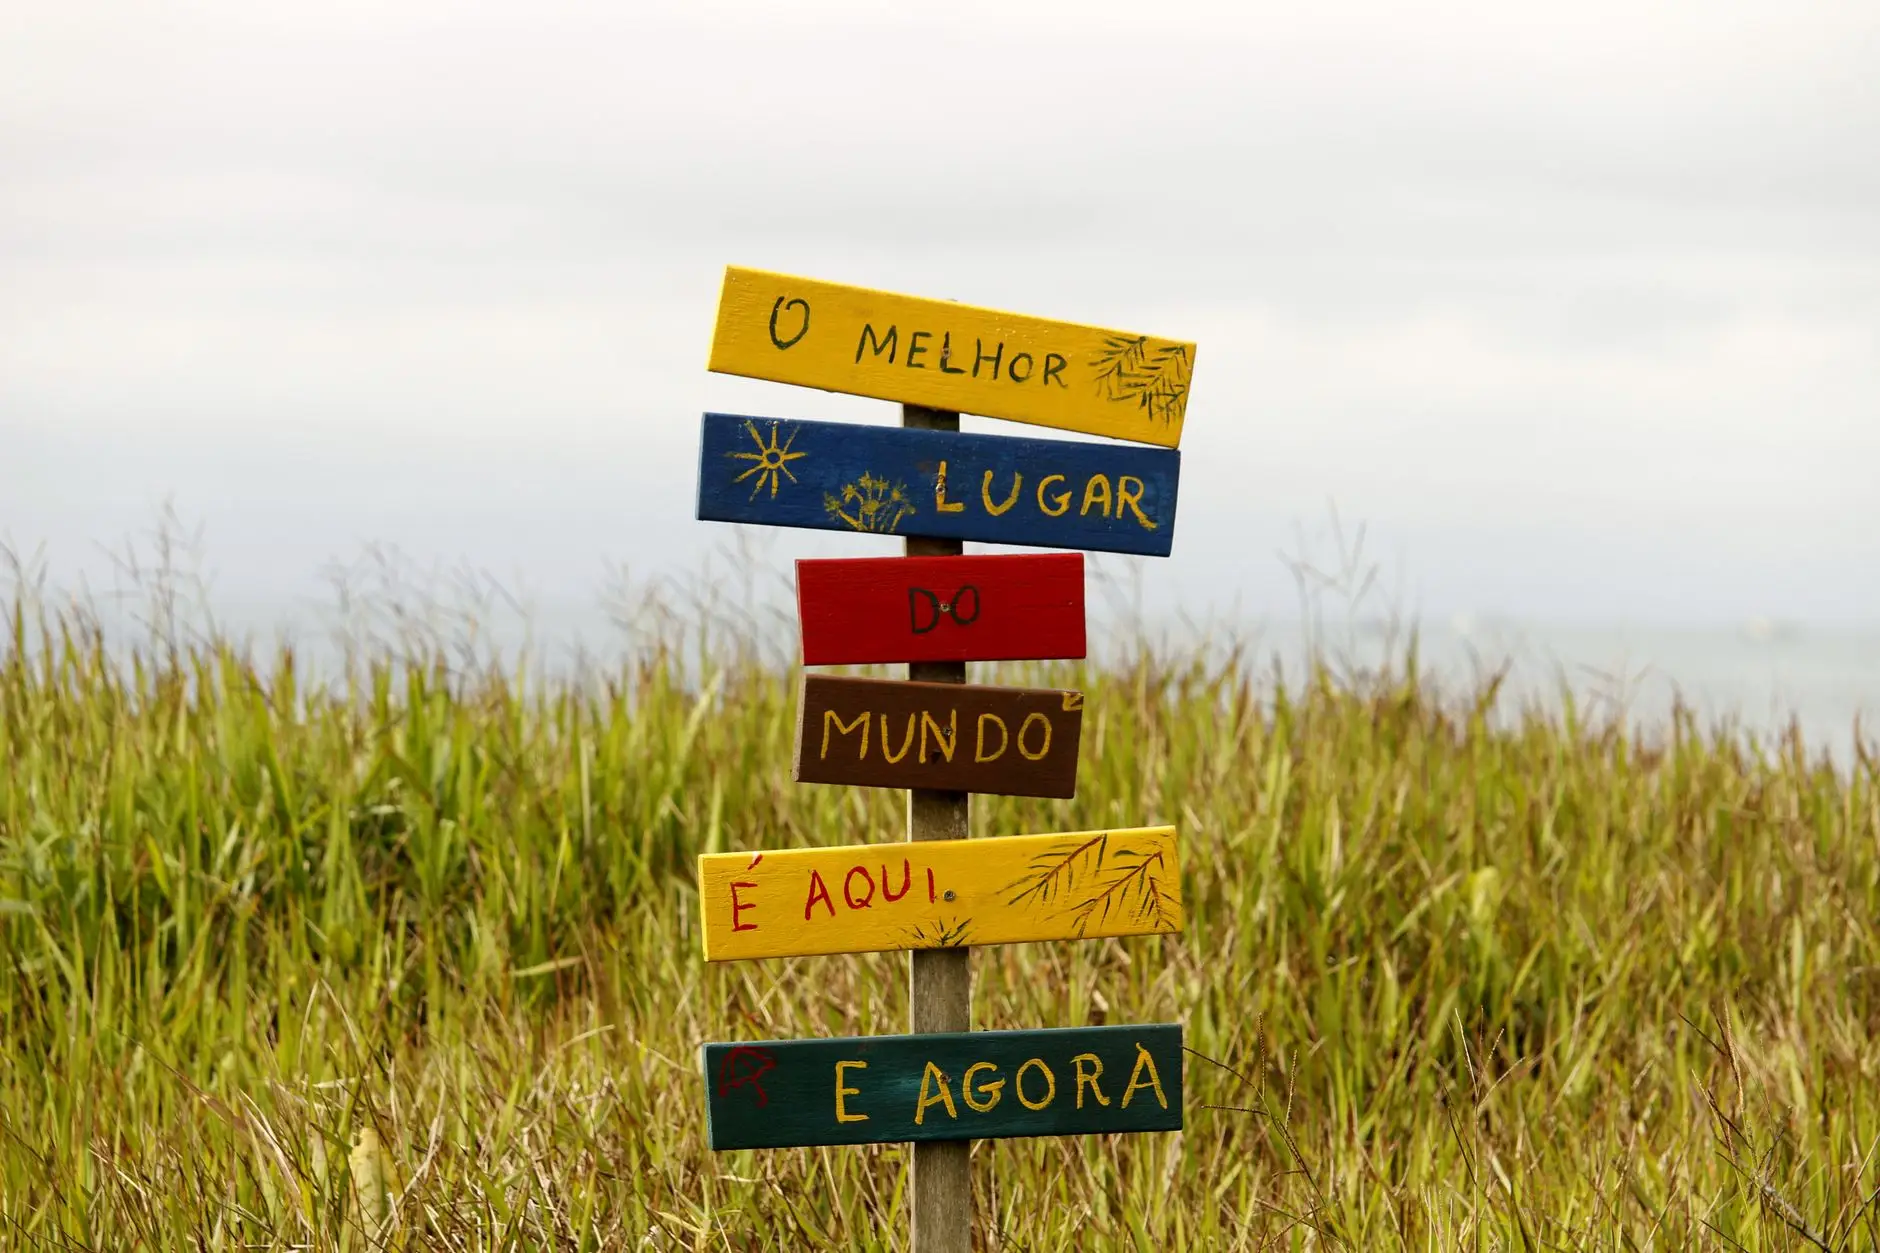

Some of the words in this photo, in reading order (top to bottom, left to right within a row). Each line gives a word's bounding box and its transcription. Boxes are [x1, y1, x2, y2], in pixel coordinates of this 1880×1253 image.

[769, 295, 809, 350] O
[855, 324, 1069, 389] MELHOR
[937, 461, 1158, 530] LUGAR
[909, 585, 980, 634] DO
[821, 709, 1052, 763] MUNDO
[730, 854, 763, 932] É
[804, 859, 936, 921] AQUI
[835, 1060, 869, 1124] E
[915, 1041, 1168, 1126] AGORA
